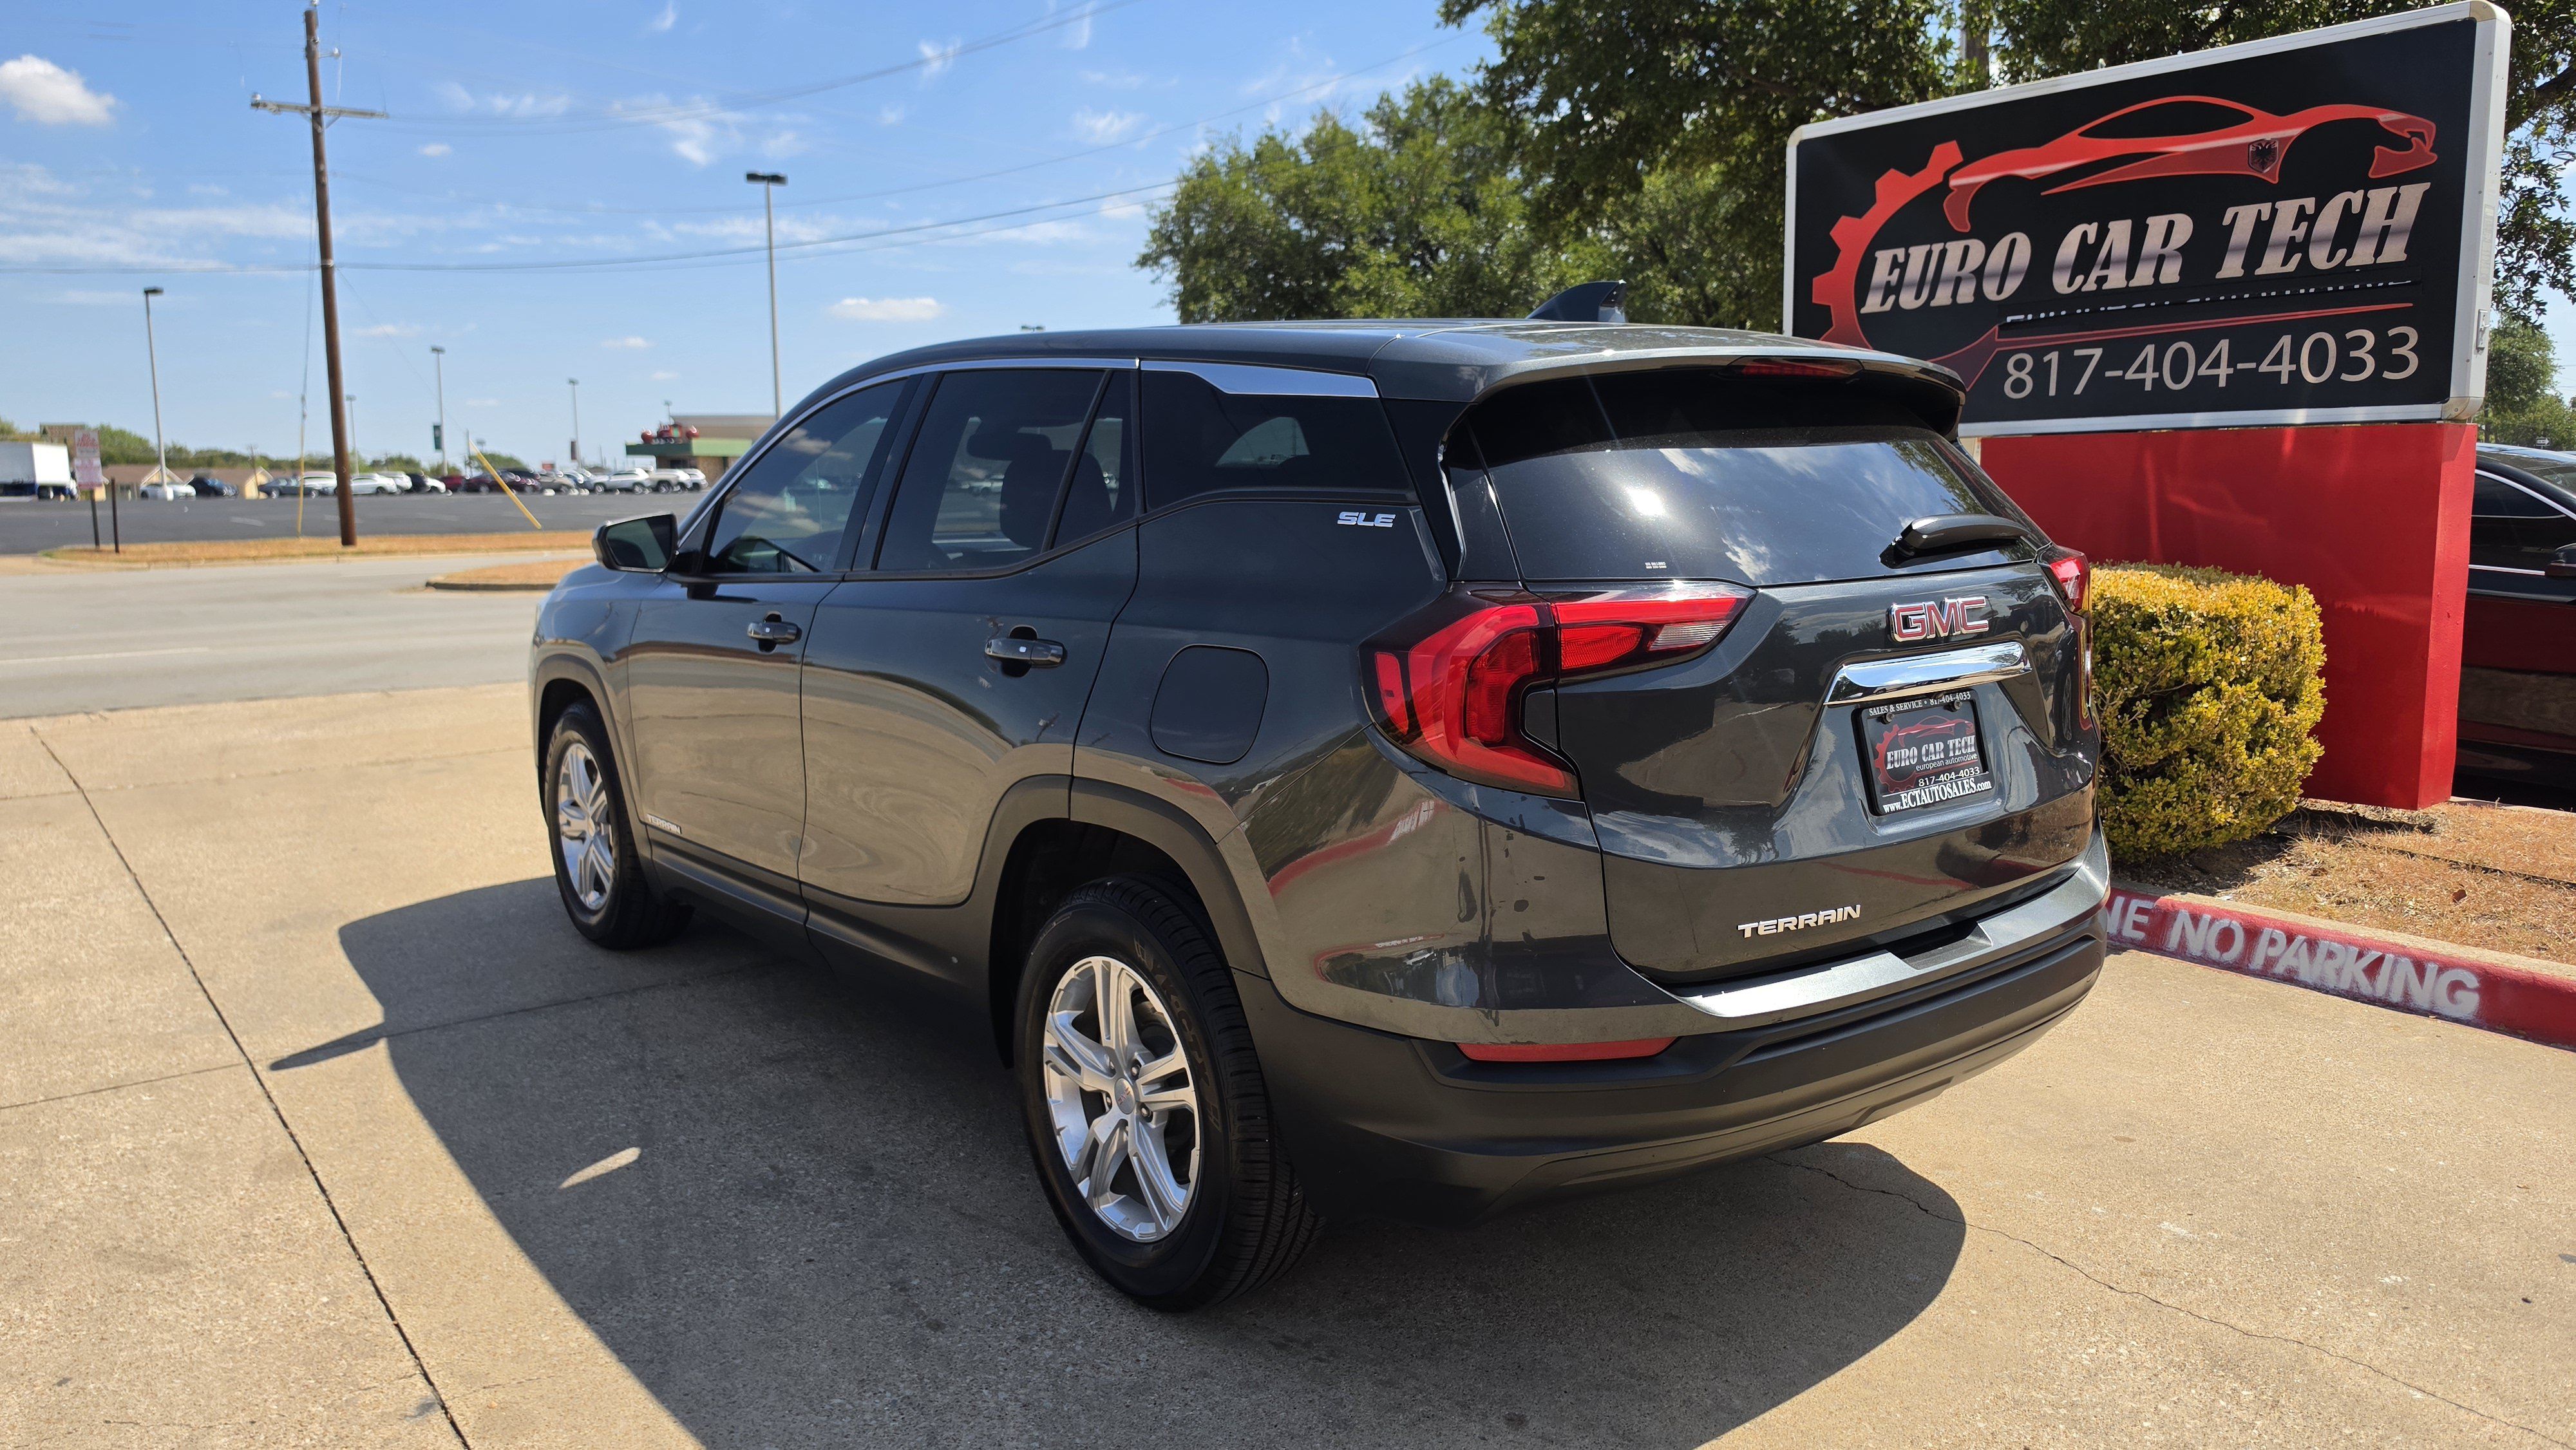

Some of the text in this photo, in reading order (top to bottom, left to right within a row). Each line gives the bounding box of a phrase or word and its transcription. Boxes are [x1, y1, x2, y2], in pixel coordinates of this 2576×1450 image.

[1860, 232, 2031, 314] EURO
[2052, 213, 2193, 294] CAR
[2215, 182, 2431, 279] TECH
[2003, 326, 2419, 399] 817-404-4033
[1338, 511, 1396, 528] SLE
[1892, 596, 1989, 642] GMC
[1869, 706, 1889, 716] SALES
[1889, 704, 1895, 713] &
[1896, 700, 1923, 711] SERVICE
[1886, 735, 1975, 770] EURO CAR TECH
[1916, 753, 1978, 771] european automotive
[1918, 766, 1980, 787] 817-404-4033
[1882, 778, 1992, 813] www.ECTAUTOSALES.com
[1738, 904, 1861, 939] TERRAIN
[2167, 909, 2244, 961] NO
[2249, 927, 2481, 1020] PARKING
